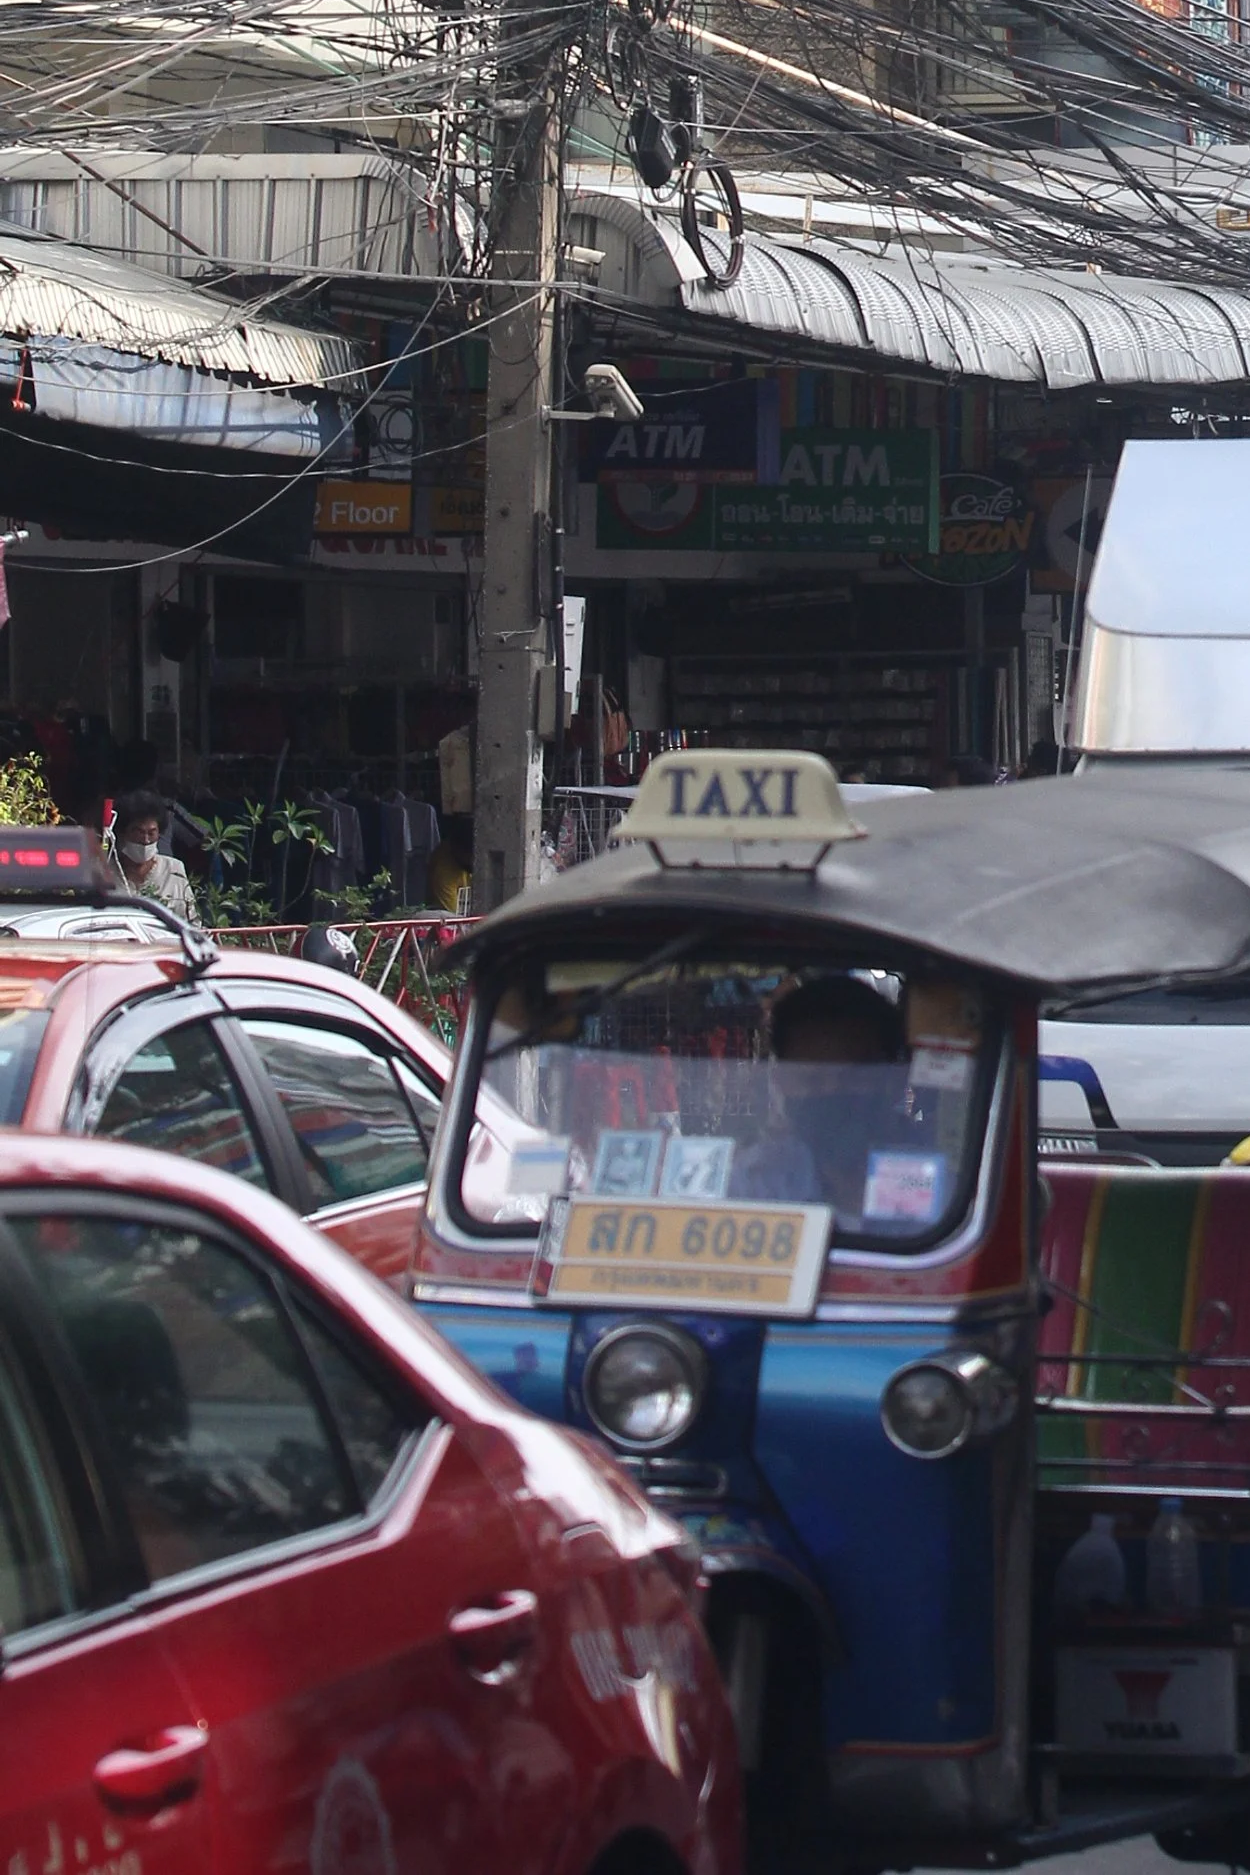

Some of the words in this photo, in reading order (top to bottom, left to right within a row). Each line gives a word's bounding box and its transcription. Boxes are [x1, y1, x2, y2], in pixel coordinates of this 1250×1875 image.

[607, 425, 705, 458] ATM
[780, 445, 890, 486] ATM
[331, 502, 400, 524] Floor
[661, 768, 799, 817] TAXI
[681, 1215, 795, 1262] 6098
